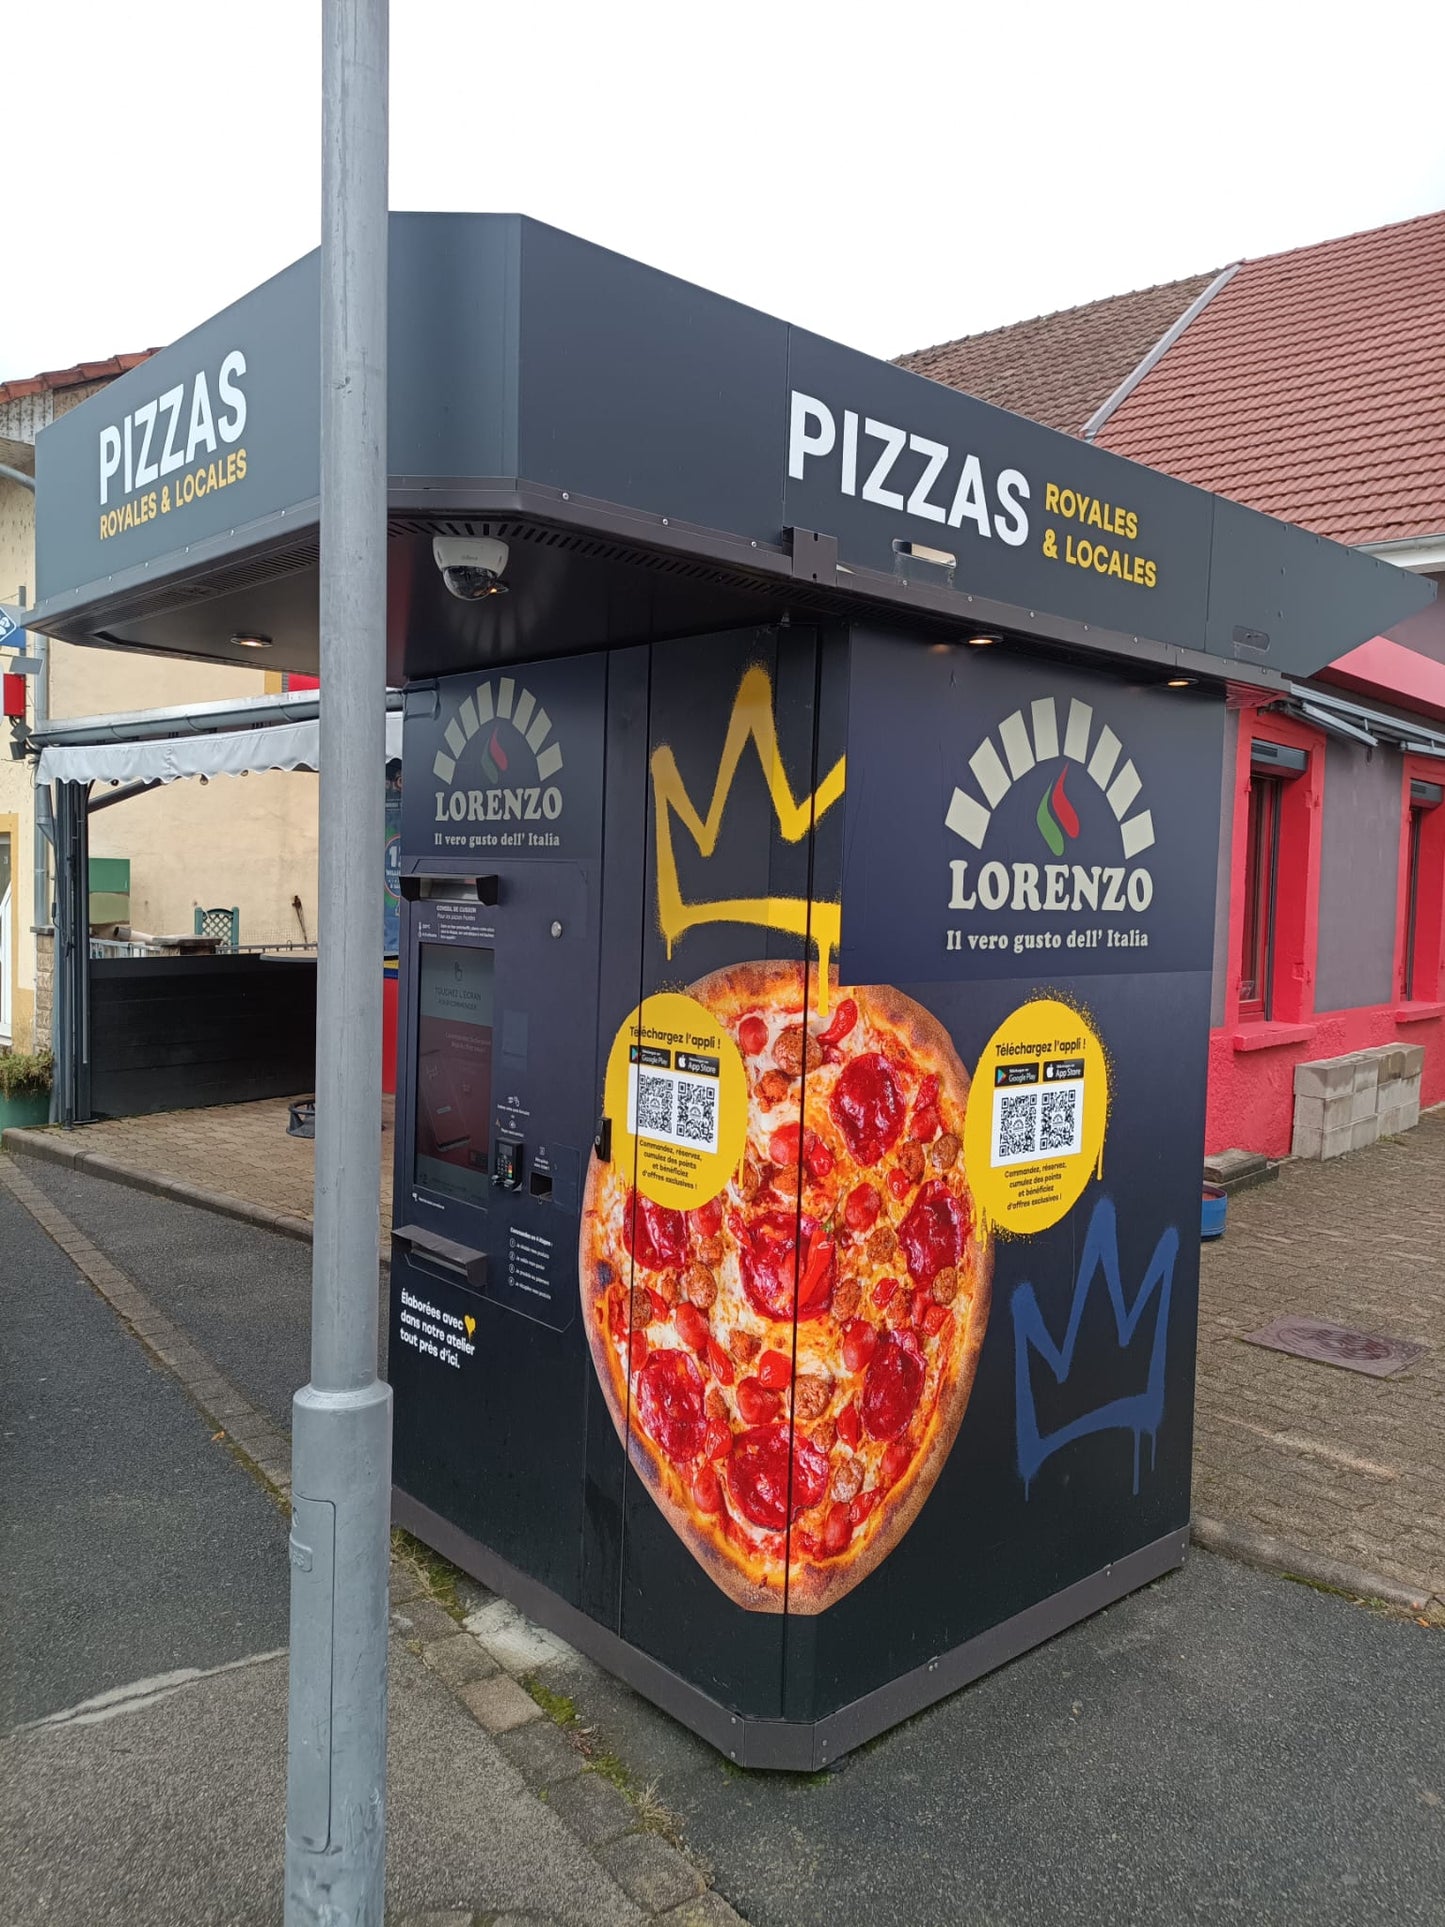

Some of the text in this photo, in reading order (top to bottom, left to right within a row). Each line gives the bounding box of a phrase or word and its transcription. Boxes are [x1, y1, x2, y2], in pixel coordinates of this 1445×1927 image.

[100, 350, 247, 505] PIZZAS
[788, 389, 1031, 547] PIZZAS
[100, 448, 247, 540] ROYALES & LOCALES
[1045, 482, 1139, 540] ROYALES
[1043, 529, 1158, 588] & LOCALES
[435, 786, 563, 821] LORENZO
[434, 832, 560, 849] Il vero gusto dell' Italia
[948, 859, 1153, 912] LORENZO
[946, 930, 962, 950] Il
[967, 933, 1009, 950] vero
[1013, 931, 1062, 954] gusto
[1106, 929, 1149, 948] Italia
[629, 1026, 684, 1045] Tééchargez
[686, 1033, 716, 1050] l'appli
[995, 1041, 1052, 1057] Téléchargez
[1054, 1037, 1082, 1055] l'appli
[641, 1054, 669, 1066] Google Play
[687, 1061, 716, 1074] App Store
[1008, 1072, 1037, 1083] Google Play
[1055, 1067, 1081, 1079] App Store
[652, 1162, 659, 1170] et
[667, 1155, 678, 1165] des
[678, 1159, 697, 1170] points
[1033, 1175, 1044, 1184] des
[1044, 1172, 1062, 1185] points
[1018, 1189, 1025, 1198] et
[401, 1287, 464, 1331] Élaborées avec
[400, 1309, 475, 1356] dans notre atelier
[400, 1327, 461, 1369] tout près d'ici.
